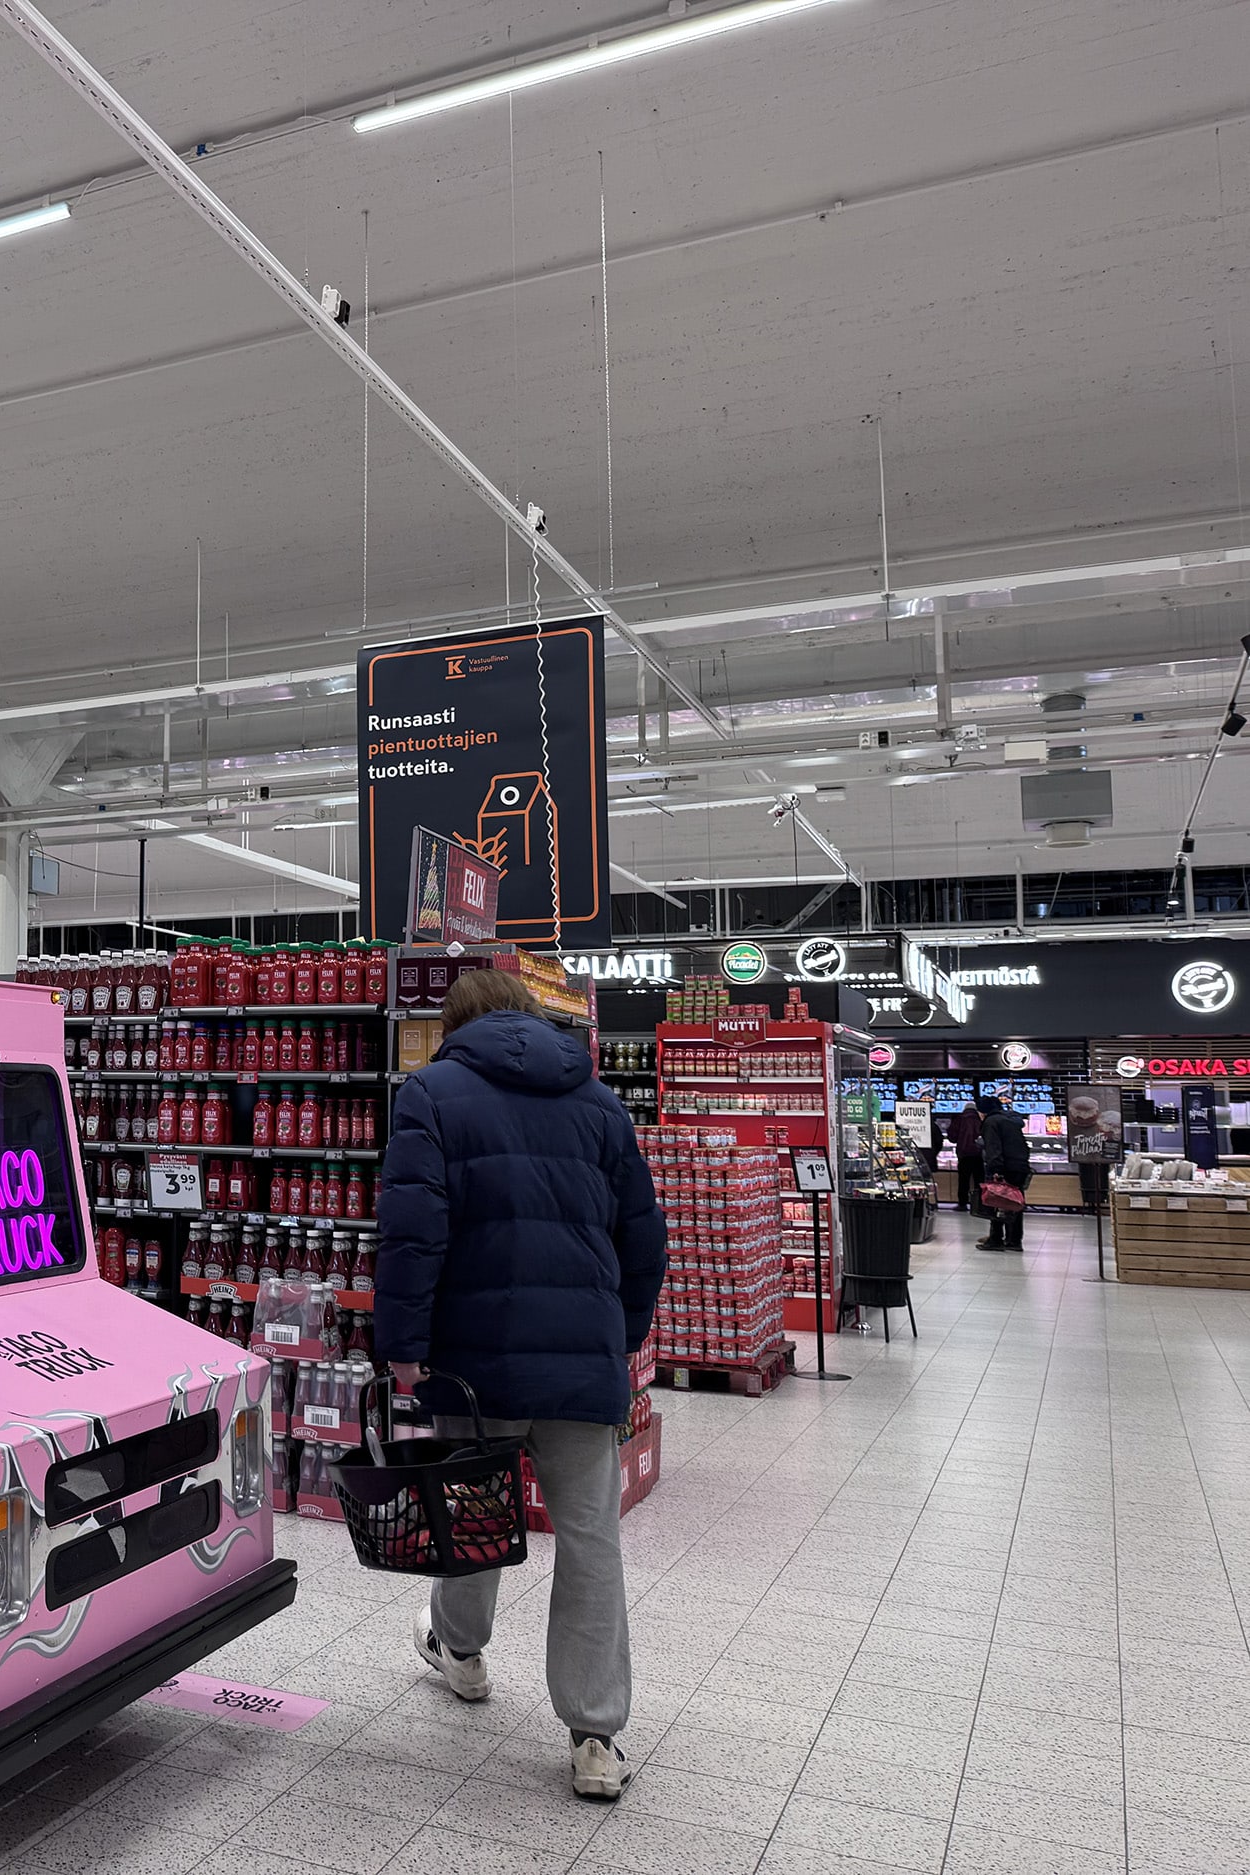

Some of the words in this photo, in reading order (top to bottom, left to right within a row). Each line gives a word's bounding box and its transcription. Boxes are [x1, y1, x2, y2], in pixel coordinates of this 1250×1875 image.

[468, 654, 509, 666] Vastuullinen
[468, 664, 493, 674] kauppa
[367, 707, 456, 732] Runsaasti
[367, 729, 498, 760] pientuottajien
[367, 758, 454, 780] tuotteita.
[463, 868, 486, 910] FELIX
[718, 1021, 760, 1031] MUTTI
[1148, 1059, 1228, 1075] OSAKA
[899, 1106, 927, 1117] UUTUUS
[165, 1173, 180, 1195] 3
[180, 1174, 196, 1184] 99
[212, 1284, 234, 1295] HEINZ
[253, 1344, 275, 1356] HEINZ
[15, 1347, 115, 1382] TRUCK
[295, 1428, 316, 1438] HEINZ
[639, 1449, 651, 1477] FELI
[301, 1506, 320, 1515] HEINZ
[212, 1696, 263, 1714] TACO
[215, 1687, 285, 1709] TRUCK
